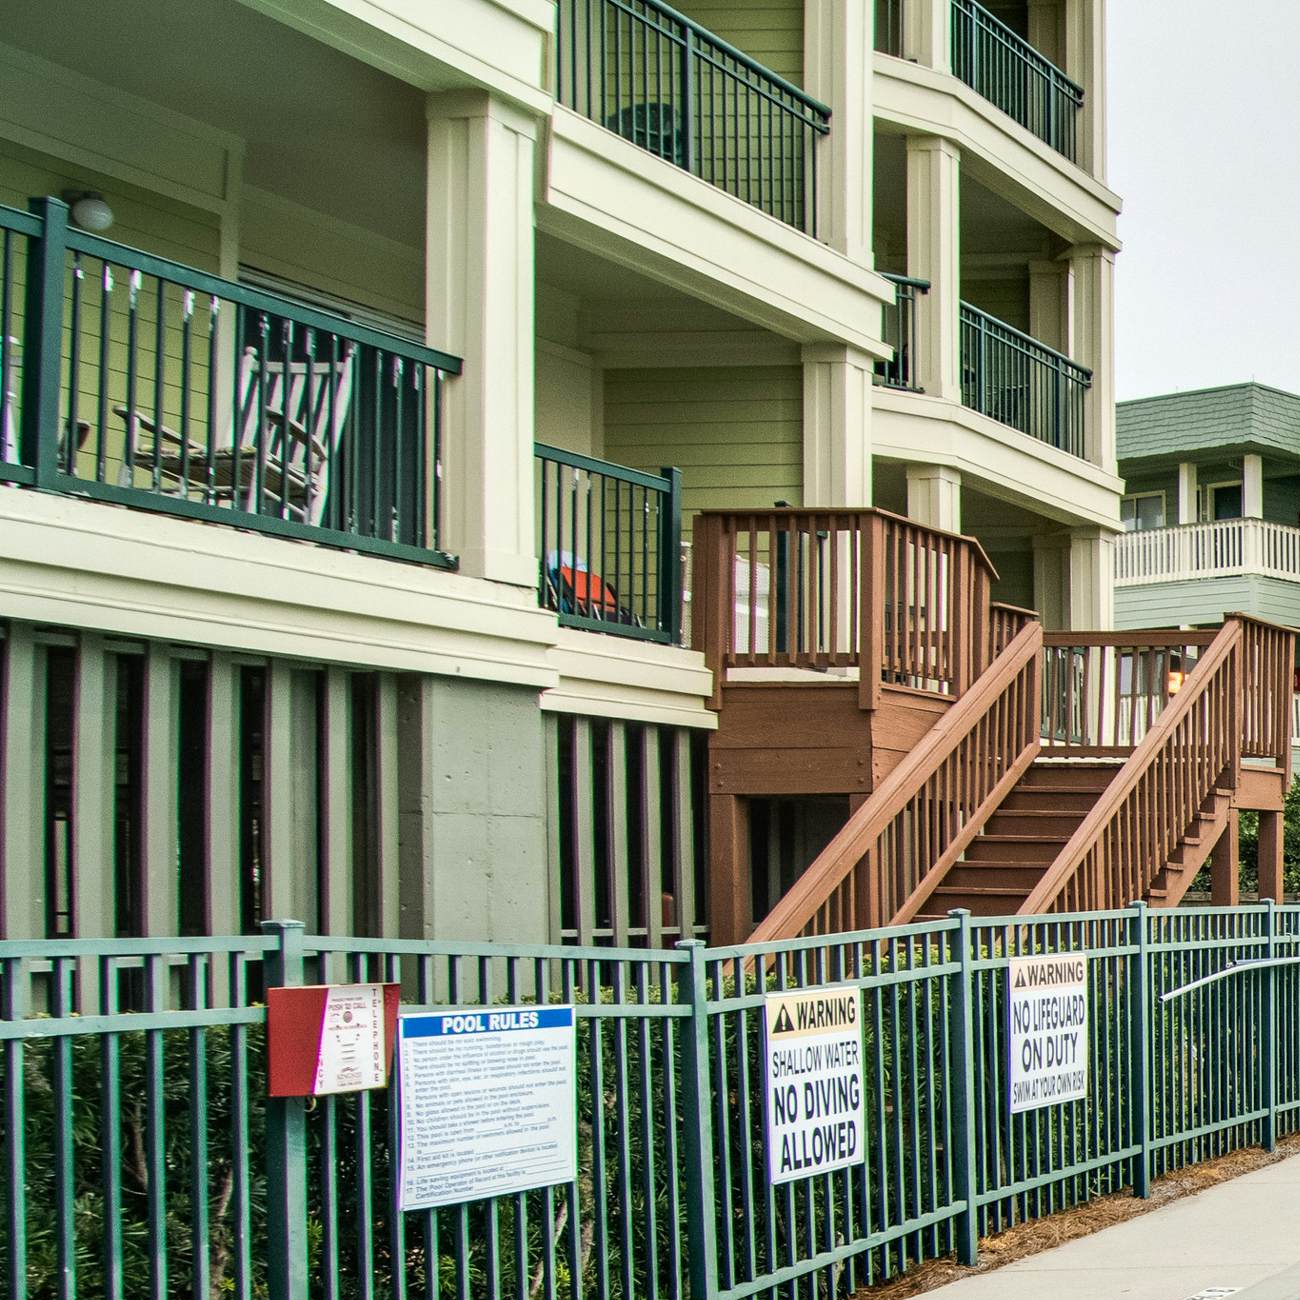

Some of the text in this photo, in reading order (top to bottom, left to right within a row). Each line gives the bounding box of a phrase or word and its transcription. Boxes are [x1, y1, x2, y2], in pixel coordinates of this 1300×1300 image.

[1027, 961, 1083, 985] WARNING
[442, 1012, 539, 1034] POOL RULES
[797, 996, 856, 1031] WARNING
[1013, 994, 1085, 1034] NO LIFEGUARD
[772, 1040, 859, 1078] SHALLOW WATER
[1022, 1032, 1078, 1072] ON DUTY
[774, 1074, 860, 1126] NO DIVING
[1013, 1070, 1085, 1104] SWIM AT YOUR OWN RISK
[780, 1120, 856, 1173] ALLOWED
